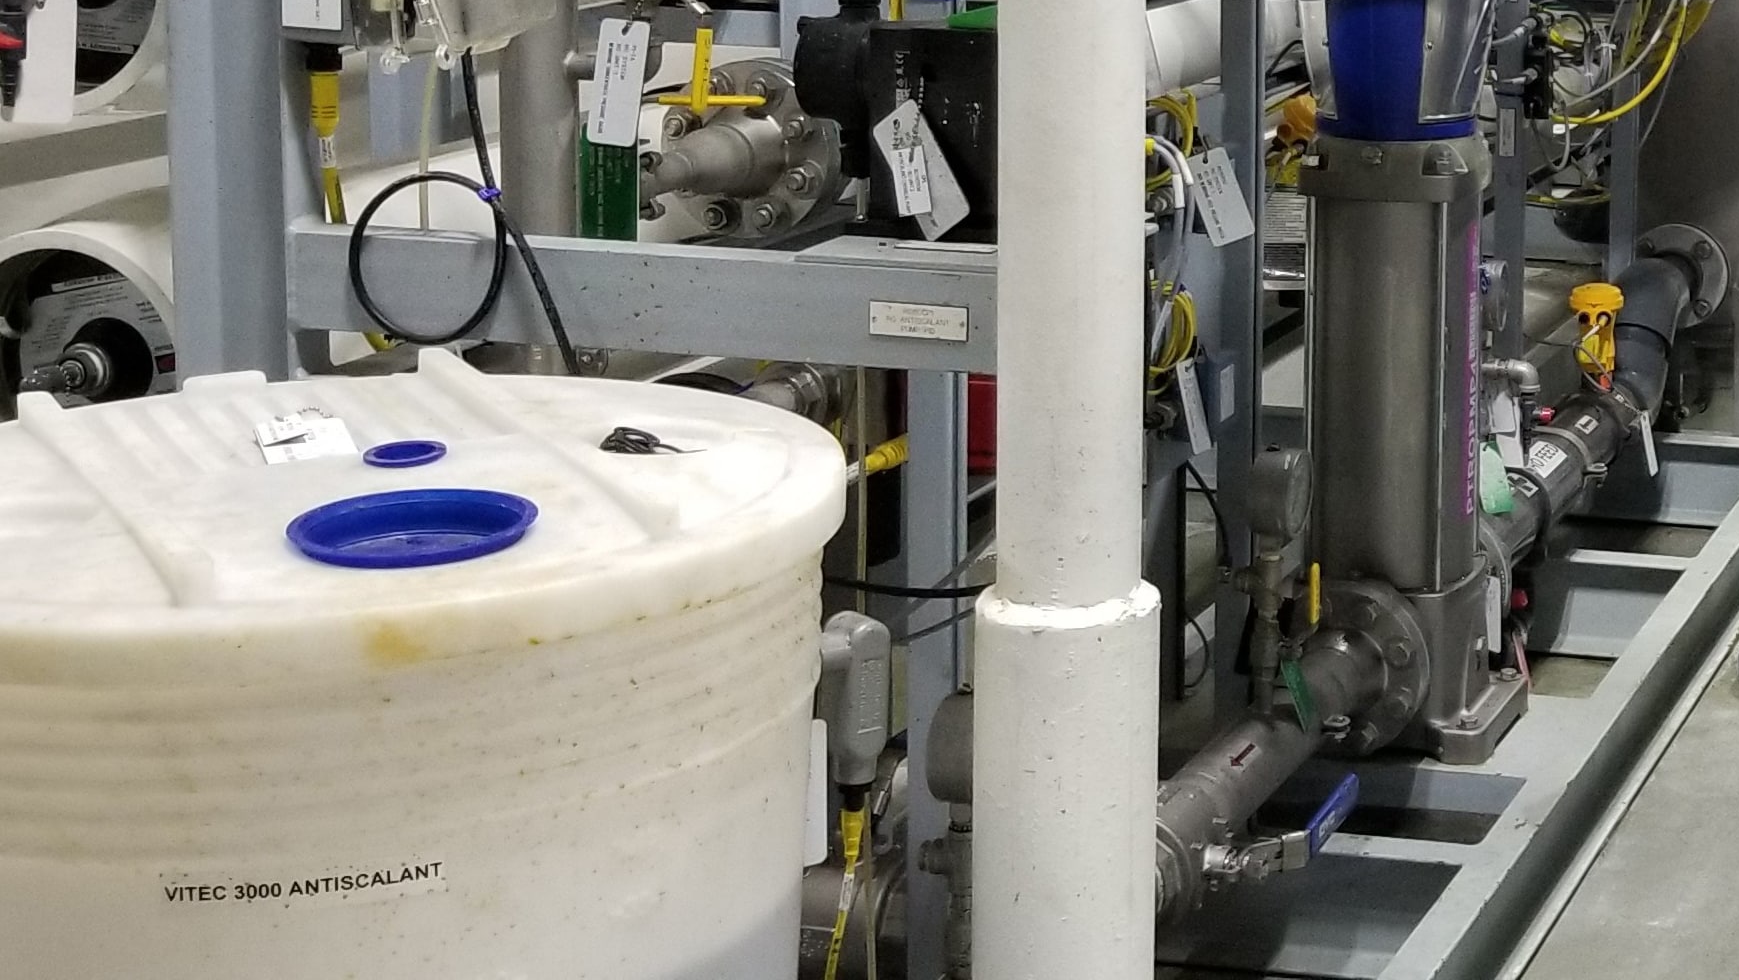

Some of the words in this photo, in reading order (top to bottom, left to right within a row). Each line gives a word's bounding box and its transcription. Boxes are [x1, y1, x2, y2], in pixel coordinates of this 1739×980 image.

[165, 886, 227, 902] VITEC
[234, 882, 282, 900] 3000
[288, 861, 443, 896] ANTISCALANT
